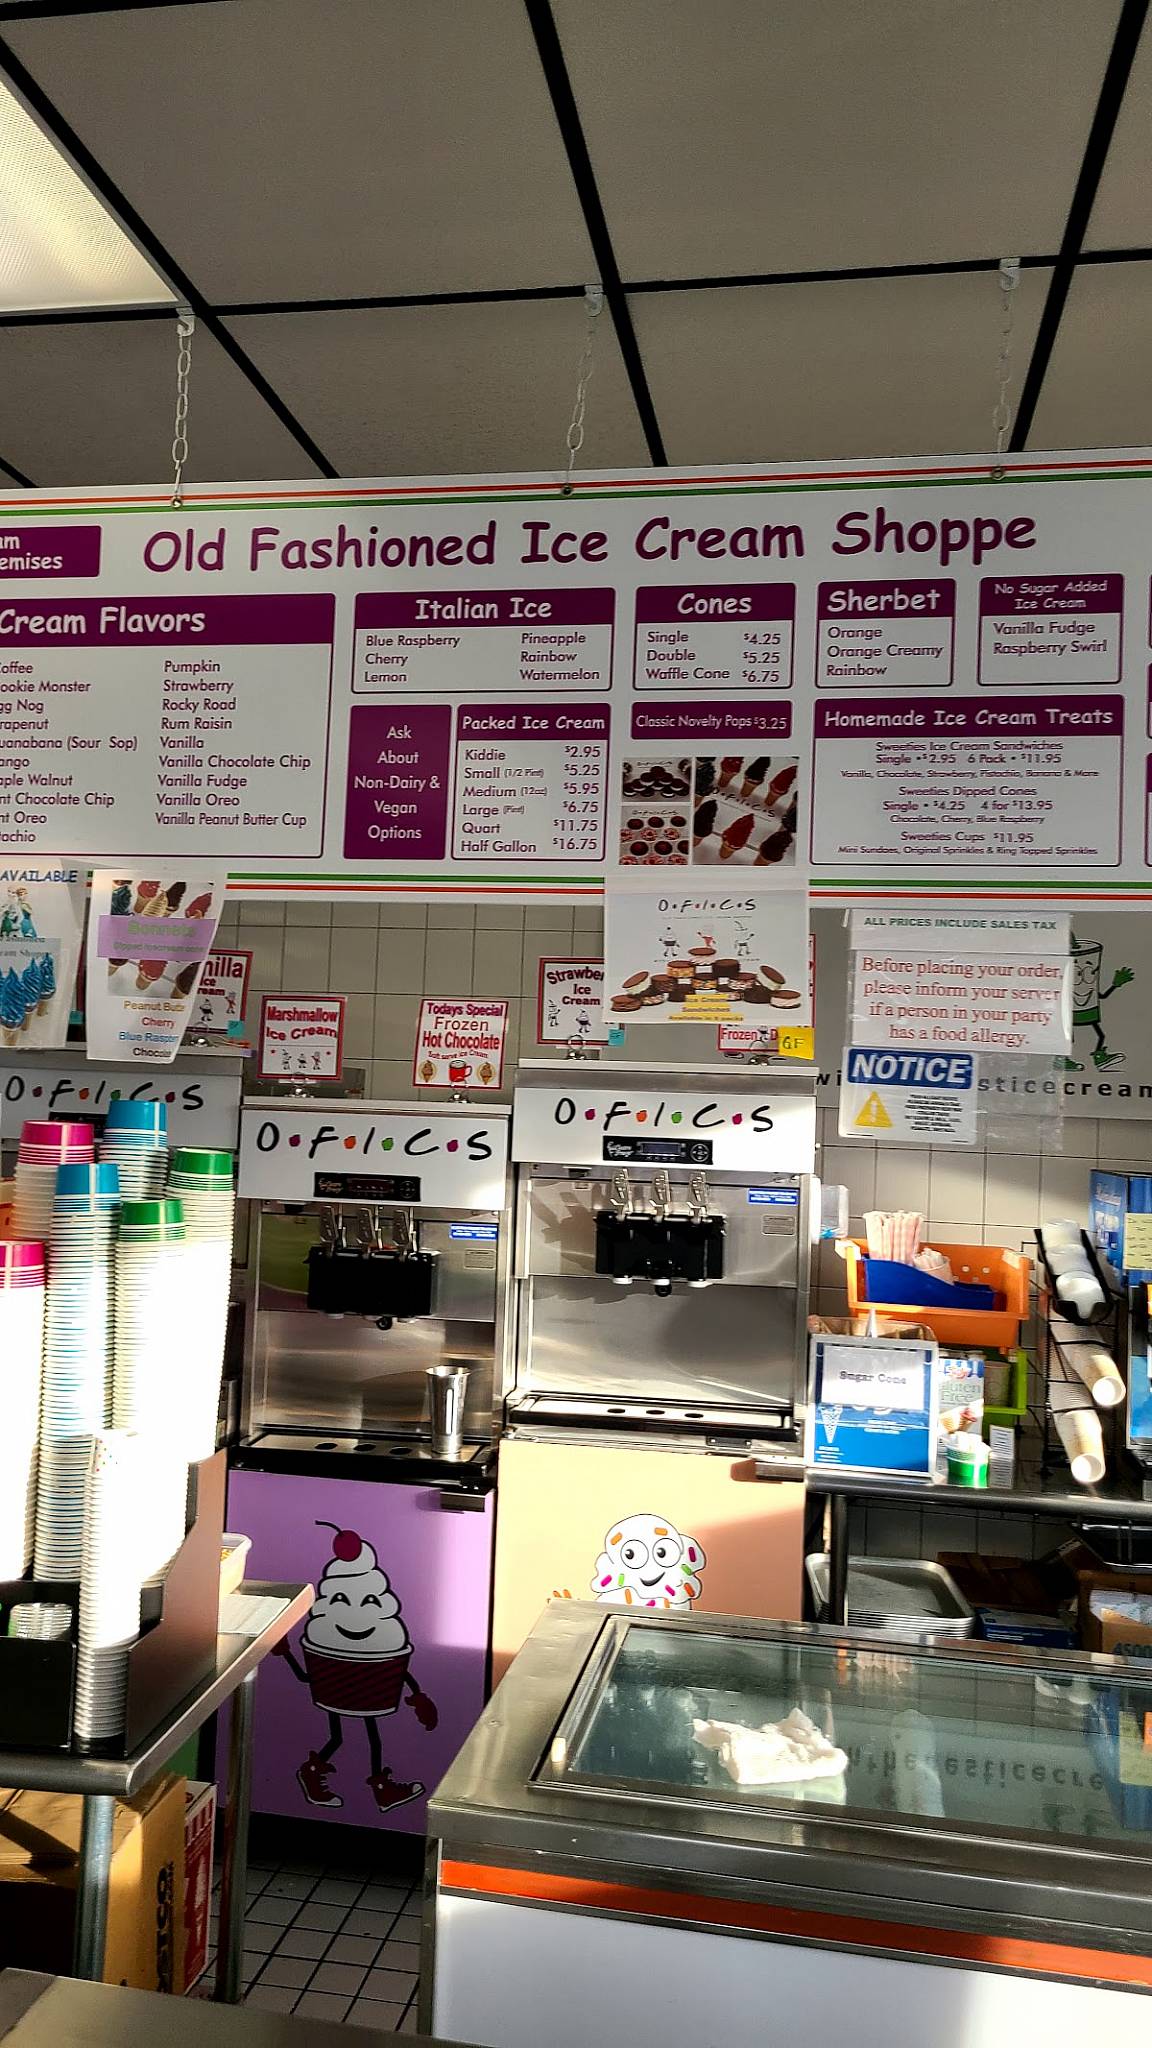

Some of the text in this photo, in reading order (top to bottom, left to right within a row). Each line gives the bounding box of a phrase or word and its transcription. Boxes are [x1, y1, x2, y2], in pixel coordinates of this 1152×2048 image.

[143, 506, 1037, 572] Old Fashioned Ice Cream Shoppe
[0, 552, 63, 571] emises
[994, 580, 1108, 597] No Sugar Added
[677, 592, 752, 615] Cones
[827, 587, 941, 612] Sherbet
[1014, 597, 1087, 610] Ice Cream
[415, 597, 552, 620] Italian Ice
[0, 606, 206, 635] Cream Flavors
[993, 620, 1096, 636] Vanilla Fudge
[521, 632, 586, 645] Pineapple
[647, 630, 781, 645] Single $4.25
[828, 626, 883, 640] Orange
[366, 634, 460, 648] Blue Raspberry
[993, 639, 1108, 657] Raspberry Swirl
[365, 653, 408, 666] Cherry
[520, 651, 577, 663] Rainbow
[647, 649, 780, 664] Double $5.25
[827, 644, 944, 660] Orange Creamy
[164, 659, 221, 676] Pumpkin
[519, 668, 600, 681] Watermelon
[645, 667, 779, 683] Waffle Cone $6.75
[826, 663, 887, 676] Rainbow
[364, 671, 407, 683] Lemon
[38, 680, 91, 693] Monster
[163, 678, 234, 694] Strawberry
[17, 700, 44, 714] Nog
[162, 697, 237, 713] Rocky Road
[161, 717, 232, 730] Rum Raisin
[462, 715, 605, 730] Packed Ice Cream
[635, 714, 787, 729] Classic Novelty Pops $3.25
[824, 709, 1114, 727] Homemade Ice Cream Treats
[386, 725, 412, 739] Ask
[67, 736, 138, 751] (Sour Sop)
[160, 735, 204, 749] Vanilla
[376, 750, 419, 764] About
[465, 745, 600, 761] Kiddie $2.95
[875, 753, 912, 765] Single
[979, 753, 1006, 763] Pack
[159, 754, 311, 770] Vanilla Chocolate Chip
[464, 763, 600, 779] Small $5.25
[28, 774, 73, 787] Walnut
[157, 774, 247, 789] Vanilla Fudge
[353, 775, 426, 793] Non-Dairy
[462, 782, 599, 797] Medium $5.95
[953, 786, 995, 797] Dipped
[999, 785, 1037, 796] Cones
[15, 793, 115, 808] Chocolate Chip
[156, 793, 240, 806] Vanilla Oreo
[882, 800, 919, 812] Single
[374, 800, 417, 817] Vegan
[462, 801, 598, 817] Large $6.75
[14, 811, 47, 825] Oreo
[155, 812, 307, 828] Vanilla Peanut Butter Cup
[367, 825, 422, 842] Options
[462, 819, 598, 834] Quart $11.75
[460, 837, 597, 852] Half Gallon $16.75
[954, 831, 985, 843] Cups
[0, 869, 79, 883] AVAILABLE
[864, 917, 1057, 930] ALL PRICES INCLUDE SALES TAX
[202, 957, 244, 978] nilla
[862, 957, 913, 973] Before
[916, 960, 973, 978] placing
[977, 966, 1014, 979] your
[573, 983, 592, 995] Ice
[864, 980, 912, 997] please
[915, 981, 969, 996] inform
[971, 987, 1008, 1000] your
[562, 995, 601, 1006] Cream
[267, 1005, 338, 1022] Marshmallow
[427, 1002, 504, 1018] Todays Special
[869, 1002, 1052, 1026] if person in your party
[434, 1016, 489, 1031] Frozen
[266, 1026, 338, 1041] Ice Cream
[422, 1030, 500, 1050] Hot Chocolate
[719, 1027, 758, 1041] Frozen
[888, 1024, 1029, 1047] has food allergy.
[851, 1053, 971, 1084] NOTICE
